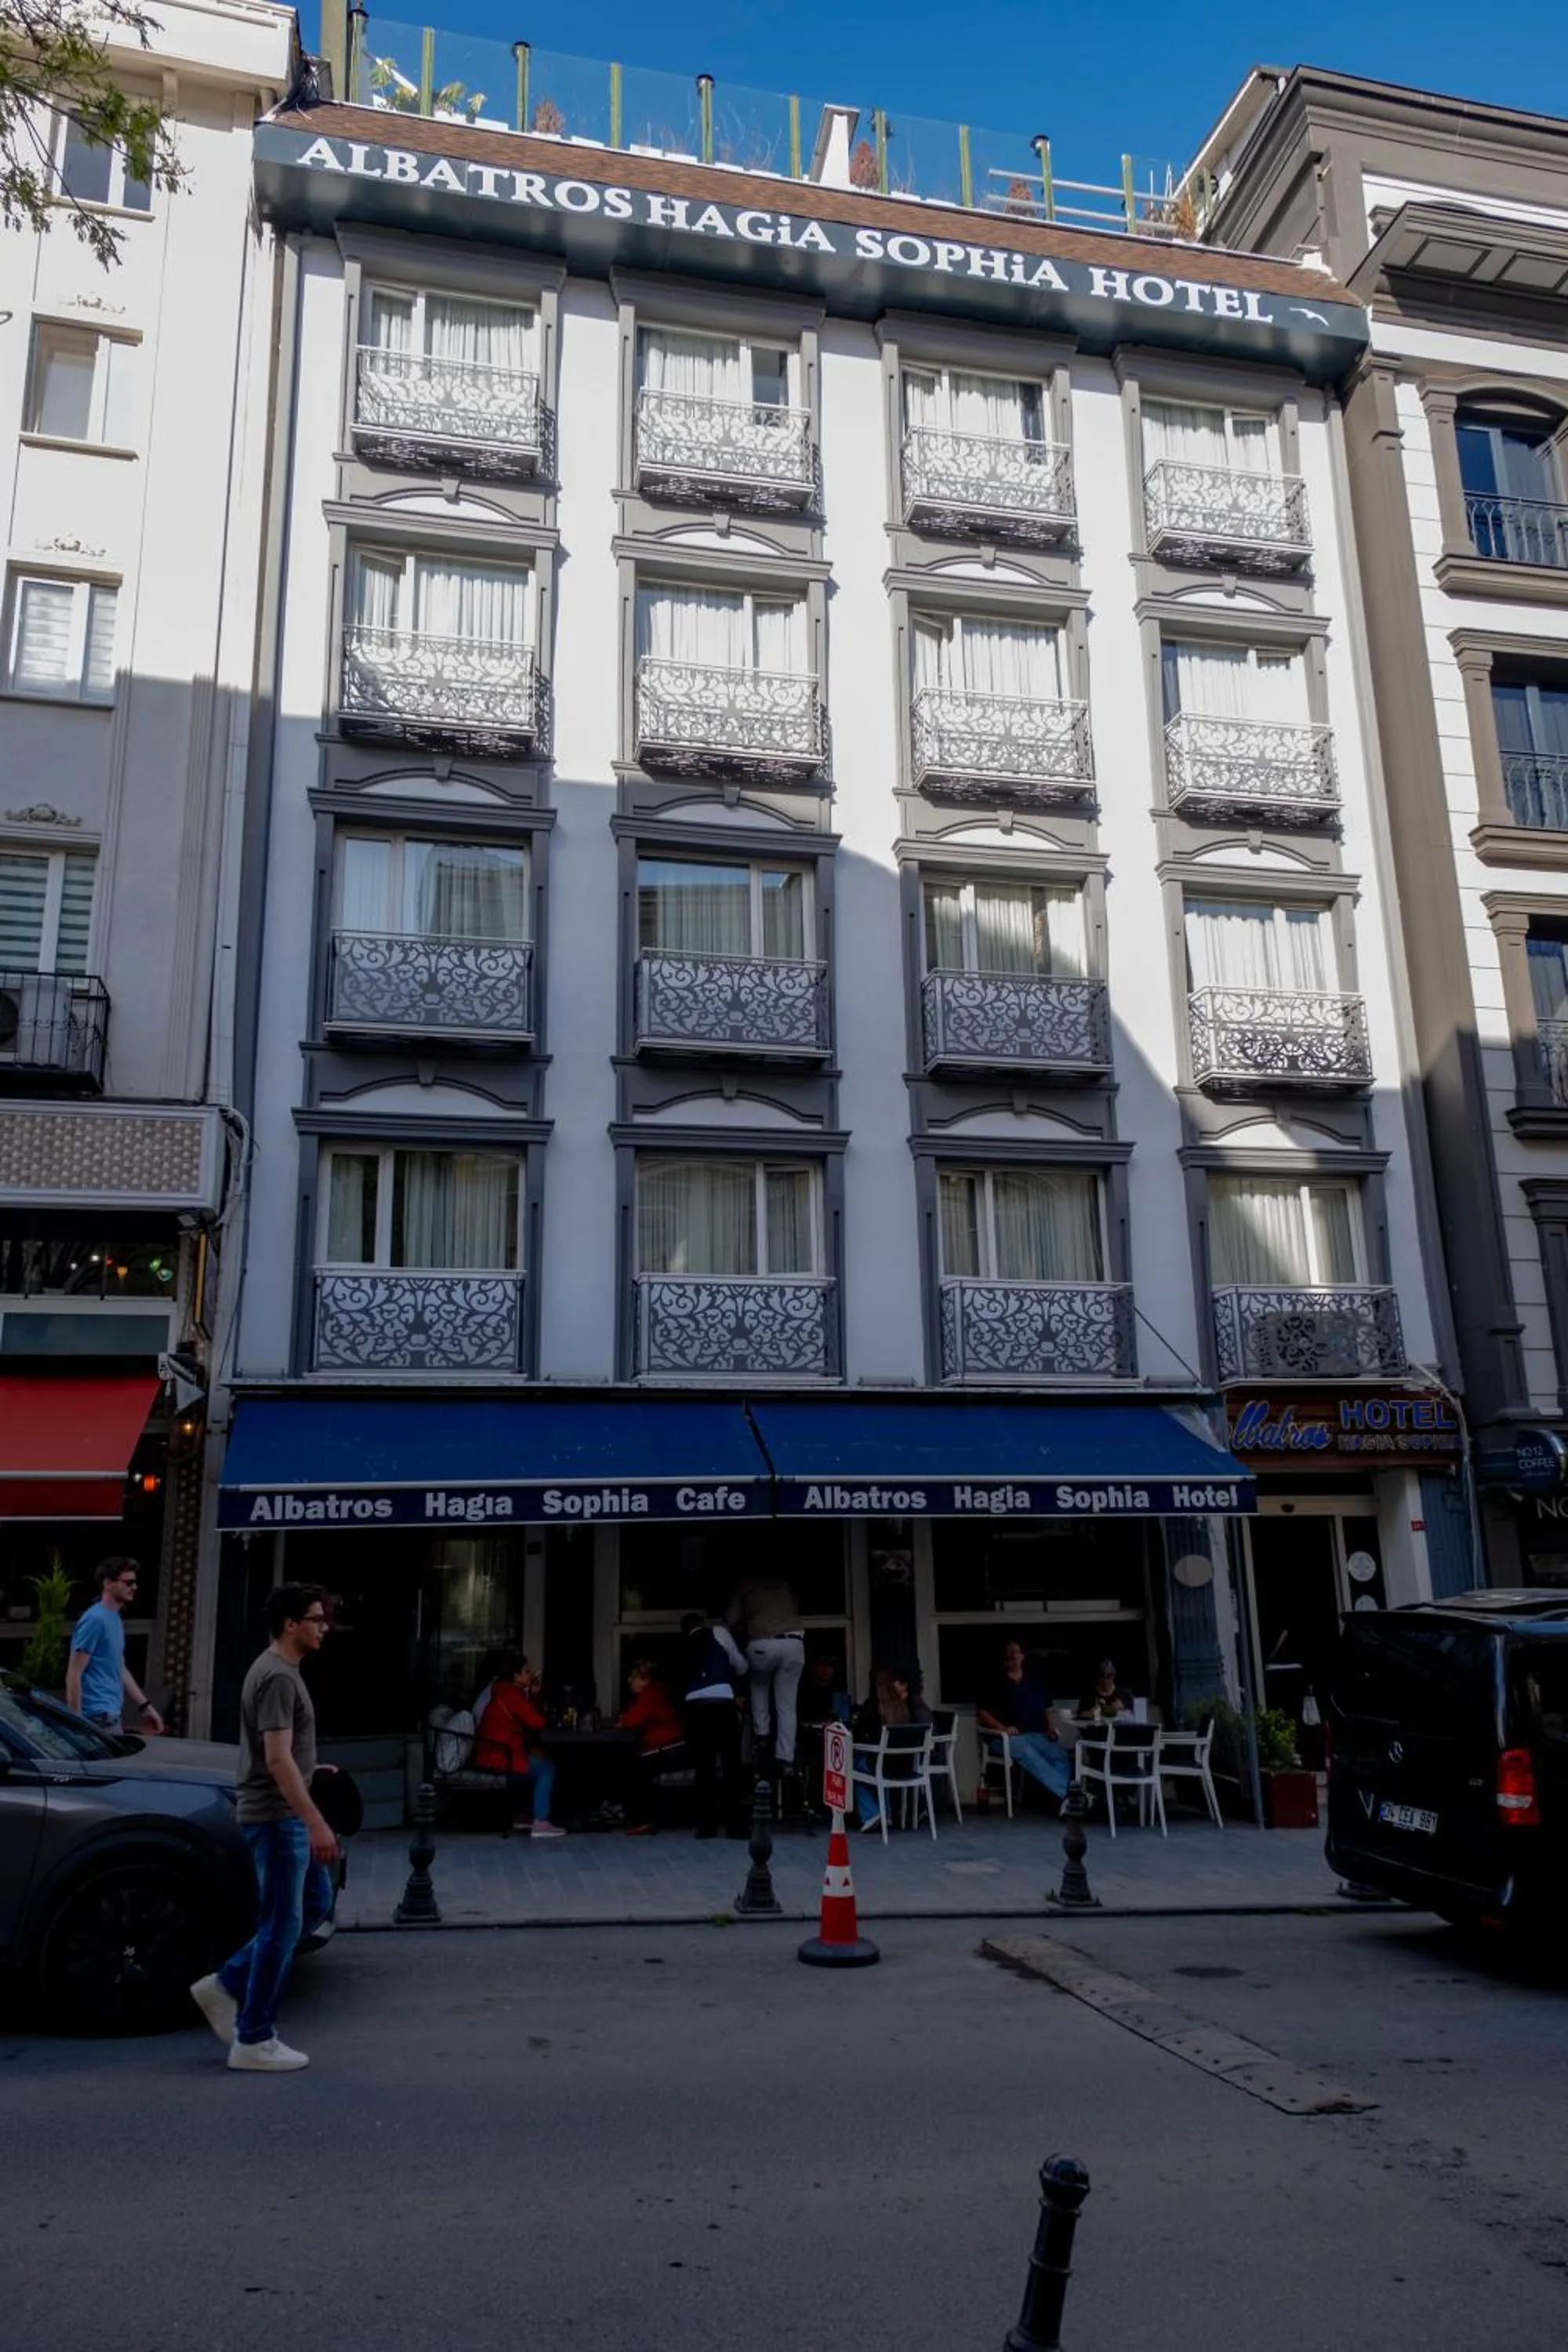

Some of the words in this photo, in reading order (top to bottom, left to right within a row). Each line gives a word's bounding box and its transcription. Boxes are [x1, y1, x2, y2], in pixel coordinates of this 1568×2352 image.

[296, 137, 633, 219] ALBATROS
[1088, 267, 1274, 324] HOTEL
[1231, 1400, 1330, 1450] lbatros
[1341, 1399, 1457, 1430] HOTEL
[1518, 1456, 1556, 1470] COFFEE
[250, 1494, 392, 1521] Albatros
[543, 1488, 648, 1519] Sophia
[677, 1486, 746, 1511] Cafe
[804, 1485, 927, 1509] Albatros
[954, 1485, 1030, 1513] Hagia
[1056, 1485, 1150, 1512] Sophia
[1172, 1485, 1238, 1508] Hotel
